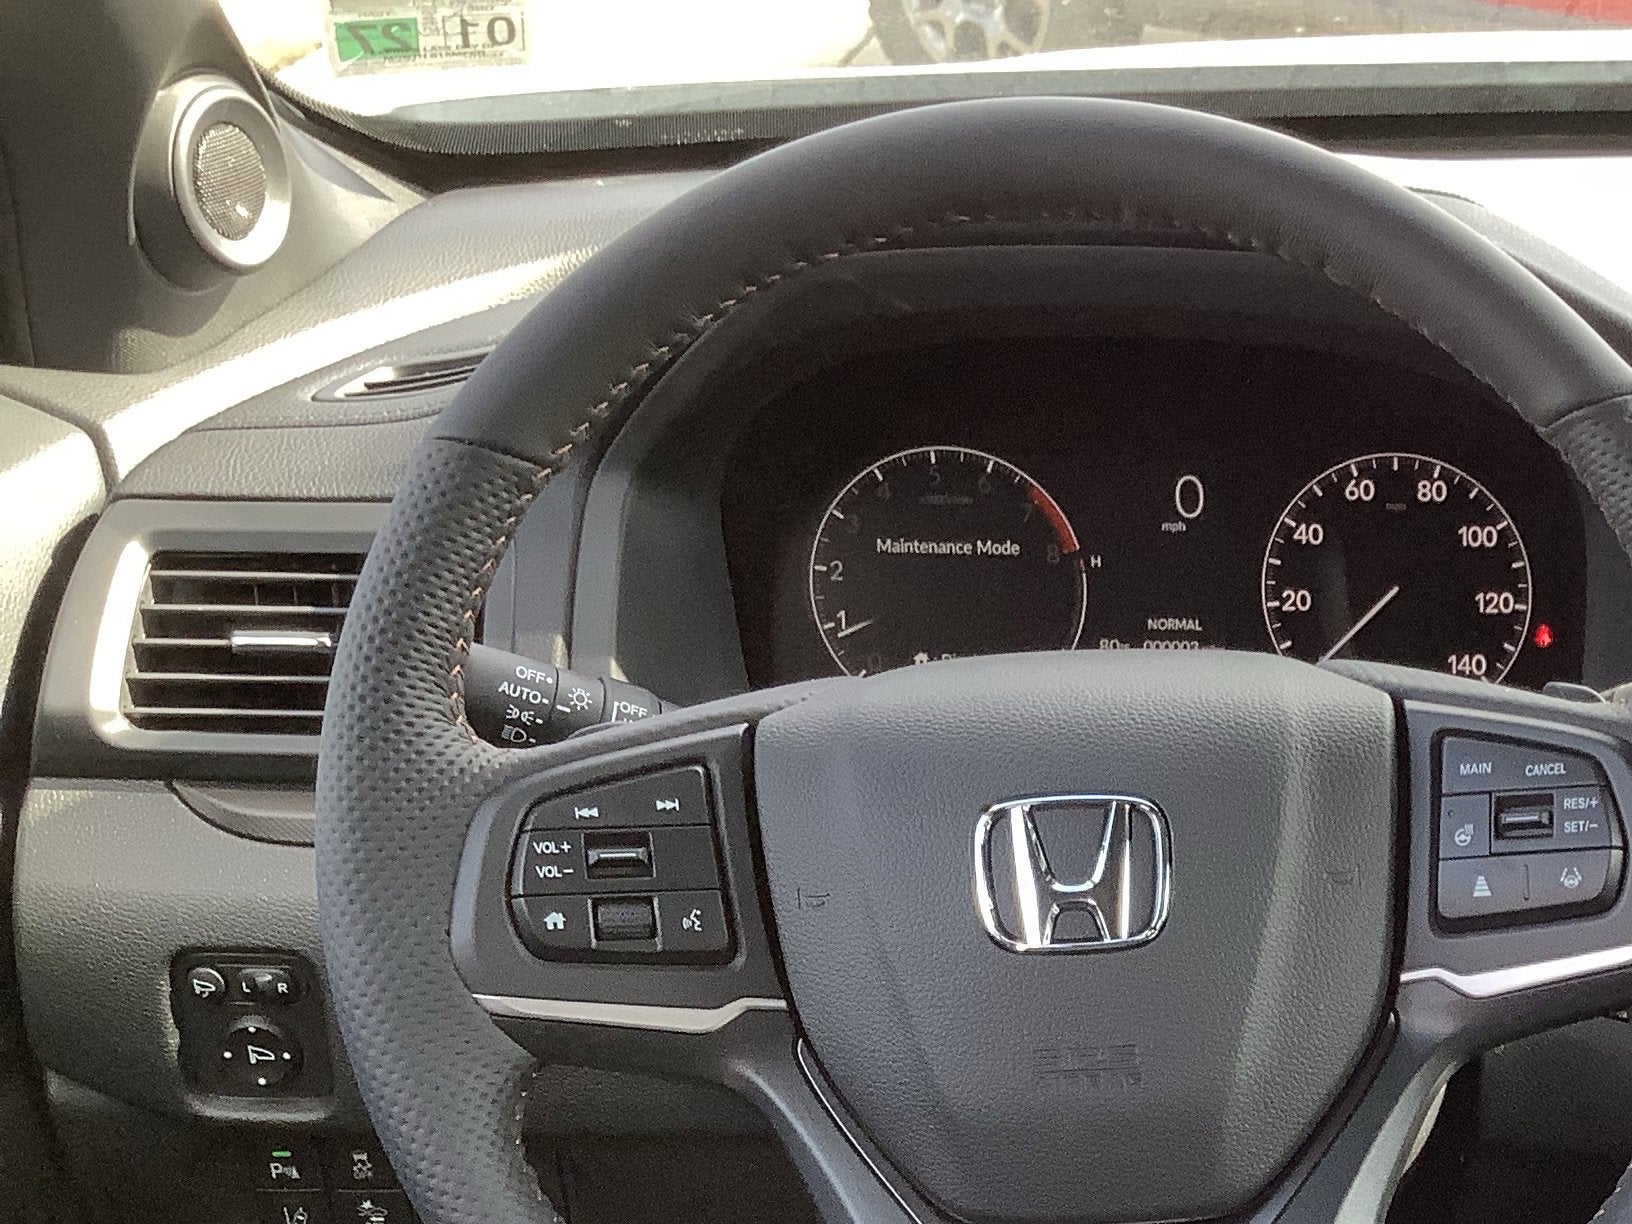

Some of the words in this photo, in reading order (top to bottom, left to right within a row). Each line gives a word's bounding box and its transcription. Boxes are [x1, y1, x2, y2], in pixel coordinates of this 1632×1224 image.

[1175, 475, 1204, 518] 0
[1345, 479, 1375, 501] 60
[1417, 479, 1447, 502] 80
[1161, 521, 1187, 534] mph
[1293, 523, 1324, 547] 40
[1457, 524, 1499, 548] 100
[876, 537, 973, 556] Maintenance
[976, 539, 1020, 556] Mode
[829, 560, 844, 581] 2
[1090, 555, 1102, 568] H
[1281, 590, 1312, 612] 20
[1474, 591, 1514, 615] 120
[835, 609, 847, 630] 1
[1147, 617, 1203, 632] NORMAL
[515, 666, 546, 683] OFF
[1447, 654, 1488, 677] 140
[498, 681, 542, 704] AUTO
[620, 701, 648, 718] OFF
[1460, 762, 1492, 776] MAIN
[1525, 762, 1567, 777] CANCEL
[277, 982, 289, 994] R
